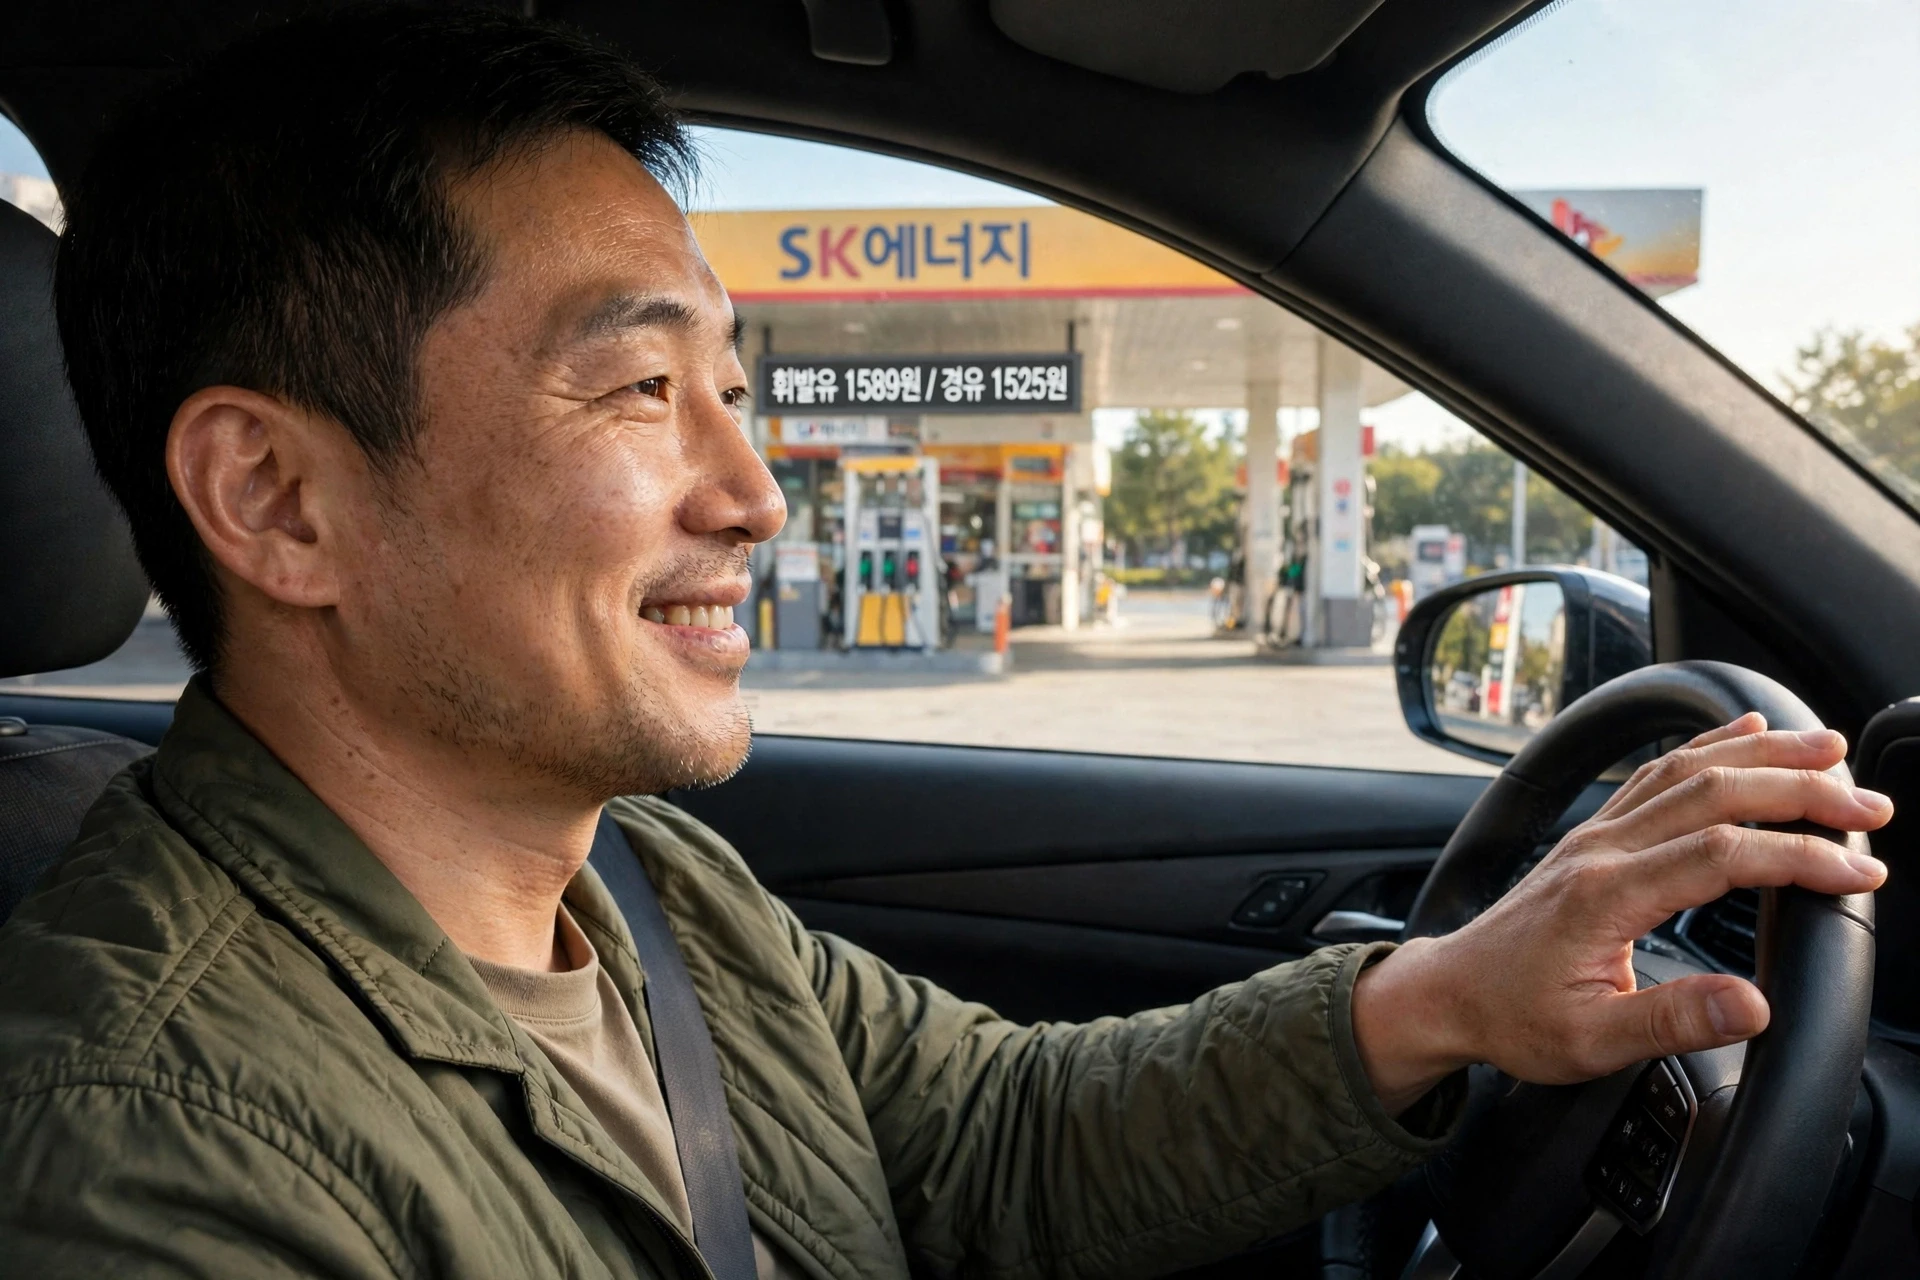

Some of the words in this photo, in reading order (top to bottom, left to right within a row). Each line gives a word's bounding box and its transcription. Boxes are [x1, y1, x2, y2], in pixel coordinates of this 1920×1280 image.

[779, 221, 1030, 280] SK에너지
[771, 366, 839, 404] 휘발유
[845, 366, 921, 402] 1589원
[924, 366, 937, 402] /
[940, 365, 986, 402] 경유
[991, 365, 1067, 401] 1525원
